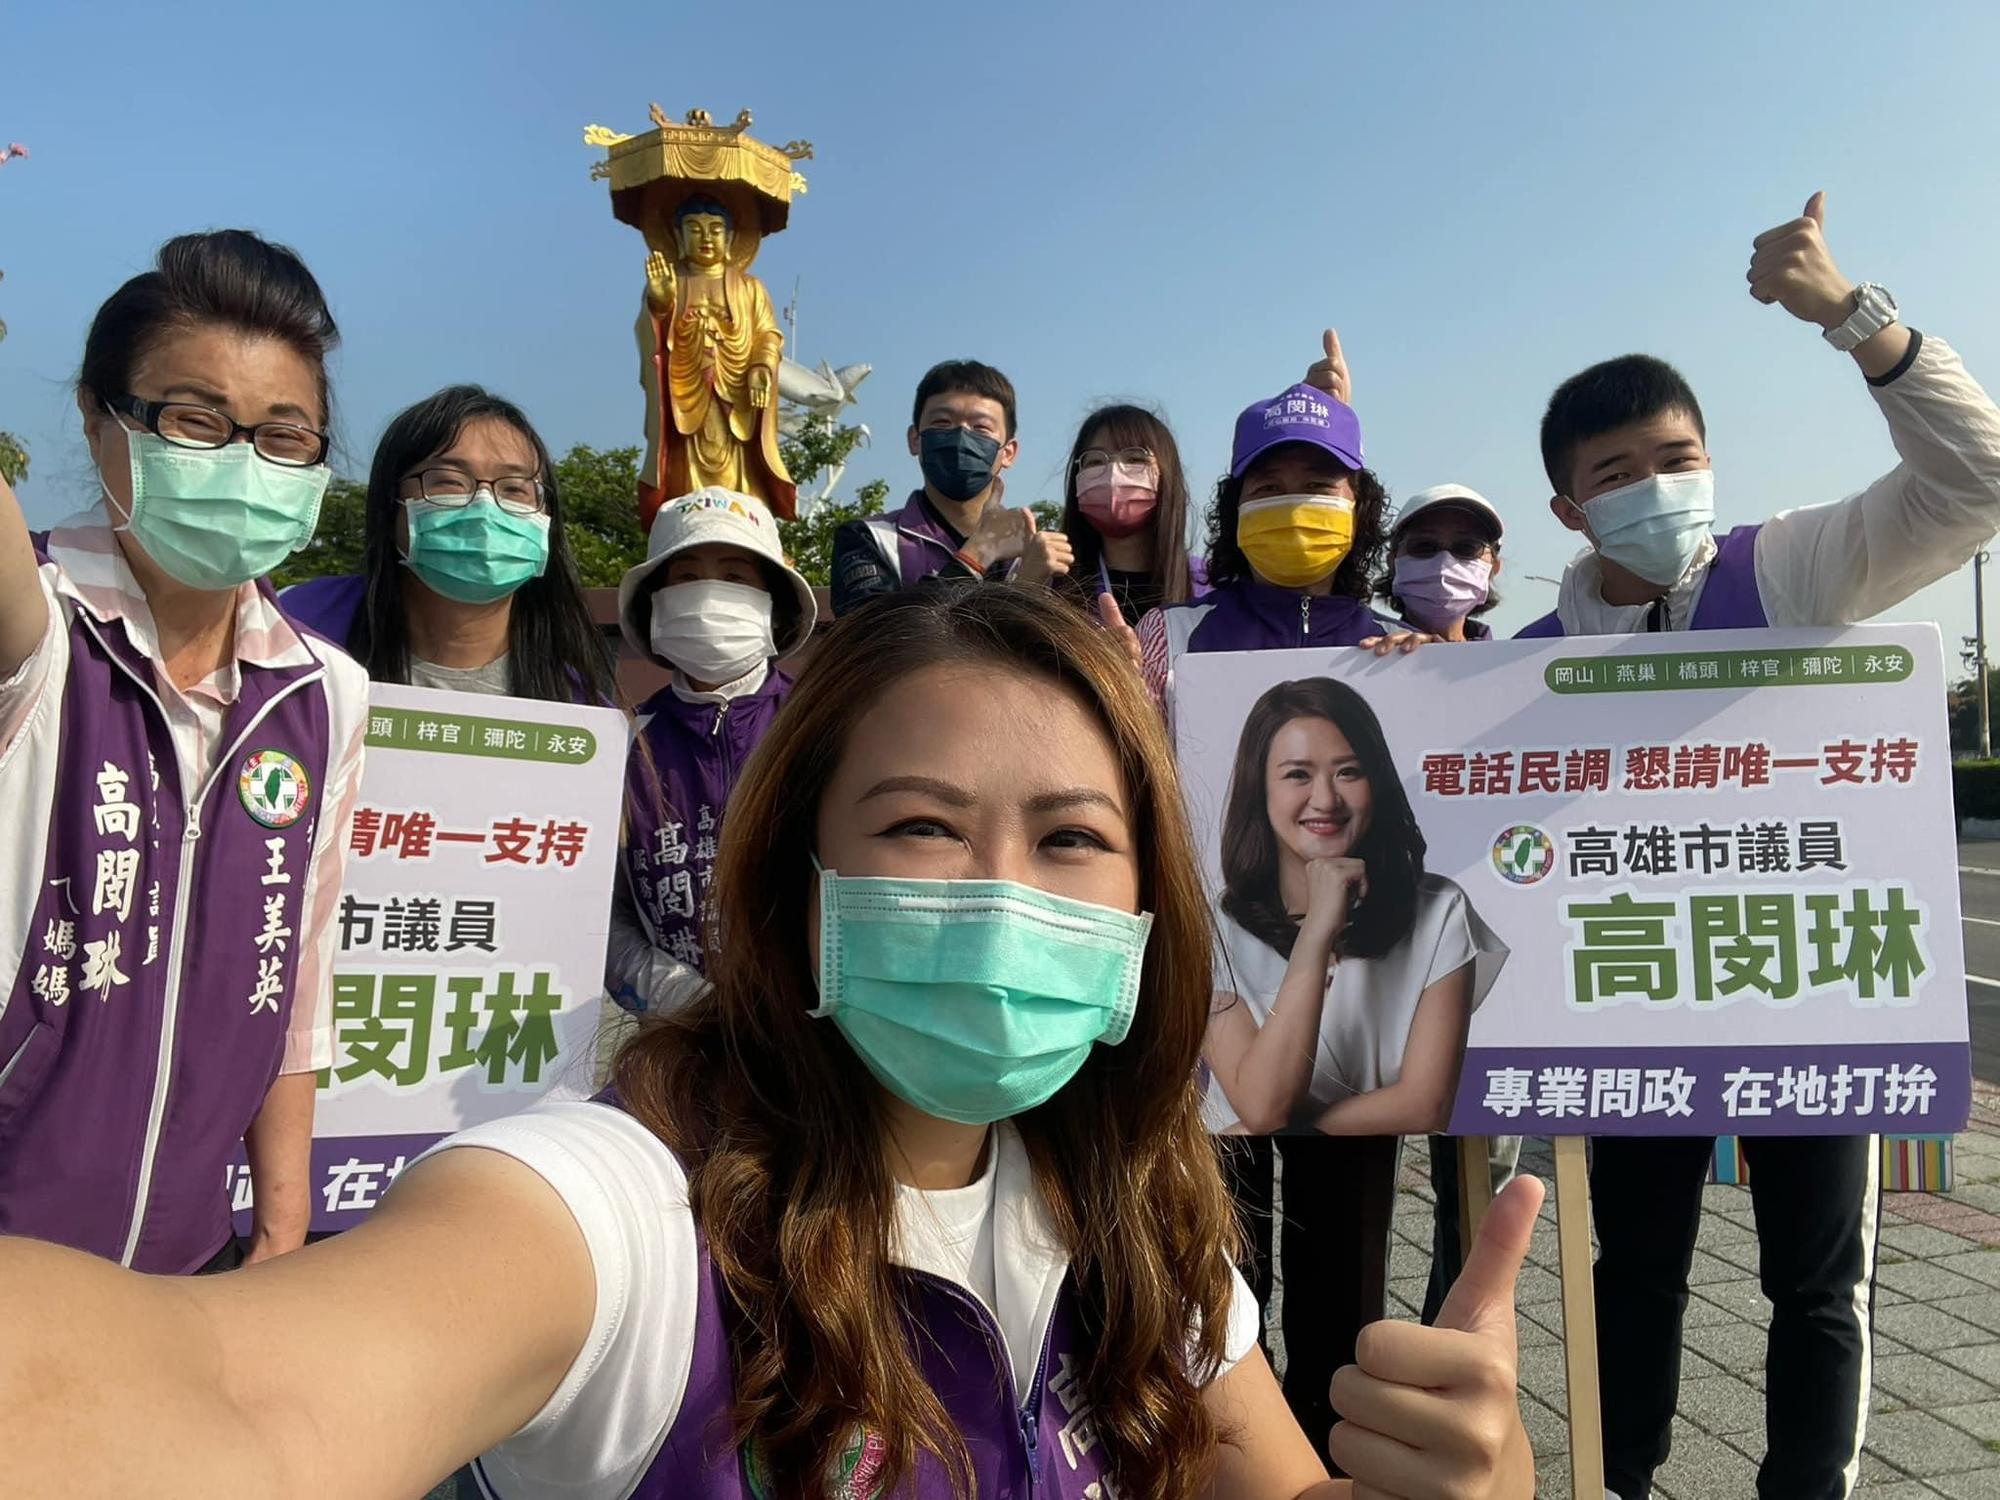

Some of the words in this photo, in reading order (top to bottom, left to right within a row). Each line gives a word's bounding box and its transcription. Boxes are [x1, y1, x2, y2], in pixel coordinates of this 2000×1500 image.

[675, 497, 760, 528] TAIWAN
[1555, 666, 1594, 685] 岡山
[1616, 662, 1656, 682] 燕巢
[1678, 660, 1719, 680] 橋頭
[1740, 658, 1780, 677] 梓官
[1802, 655, 1843, 675] 彌陀
[1864, 653, 1904, 673] 永安
[364, 716, 393, 738] 頭
[417, 720, 461, 744] 梓官
[484, 727, 525, 750] 彌陀
[547, 734, 587, 756] 永安
[1422, 748, 1611, 796] 電話民調
[1623, 738, 1918, 791] 懇請唯一支持
[1566, 820, 1848, 877] 高雄市議員
[80, 760, 141, 1003] 高閔琳
[653, 820, 704, 965] 高閔琳
[249, 836, 292, 1016] 王美英
[338, 894, 498, 953] 市議員
[1567, 887, 1926, 1002] 高閔琳
[316, 971, 563, 1089] 閔琳
[1483, 1065, 1697, 1118] 專業問政
